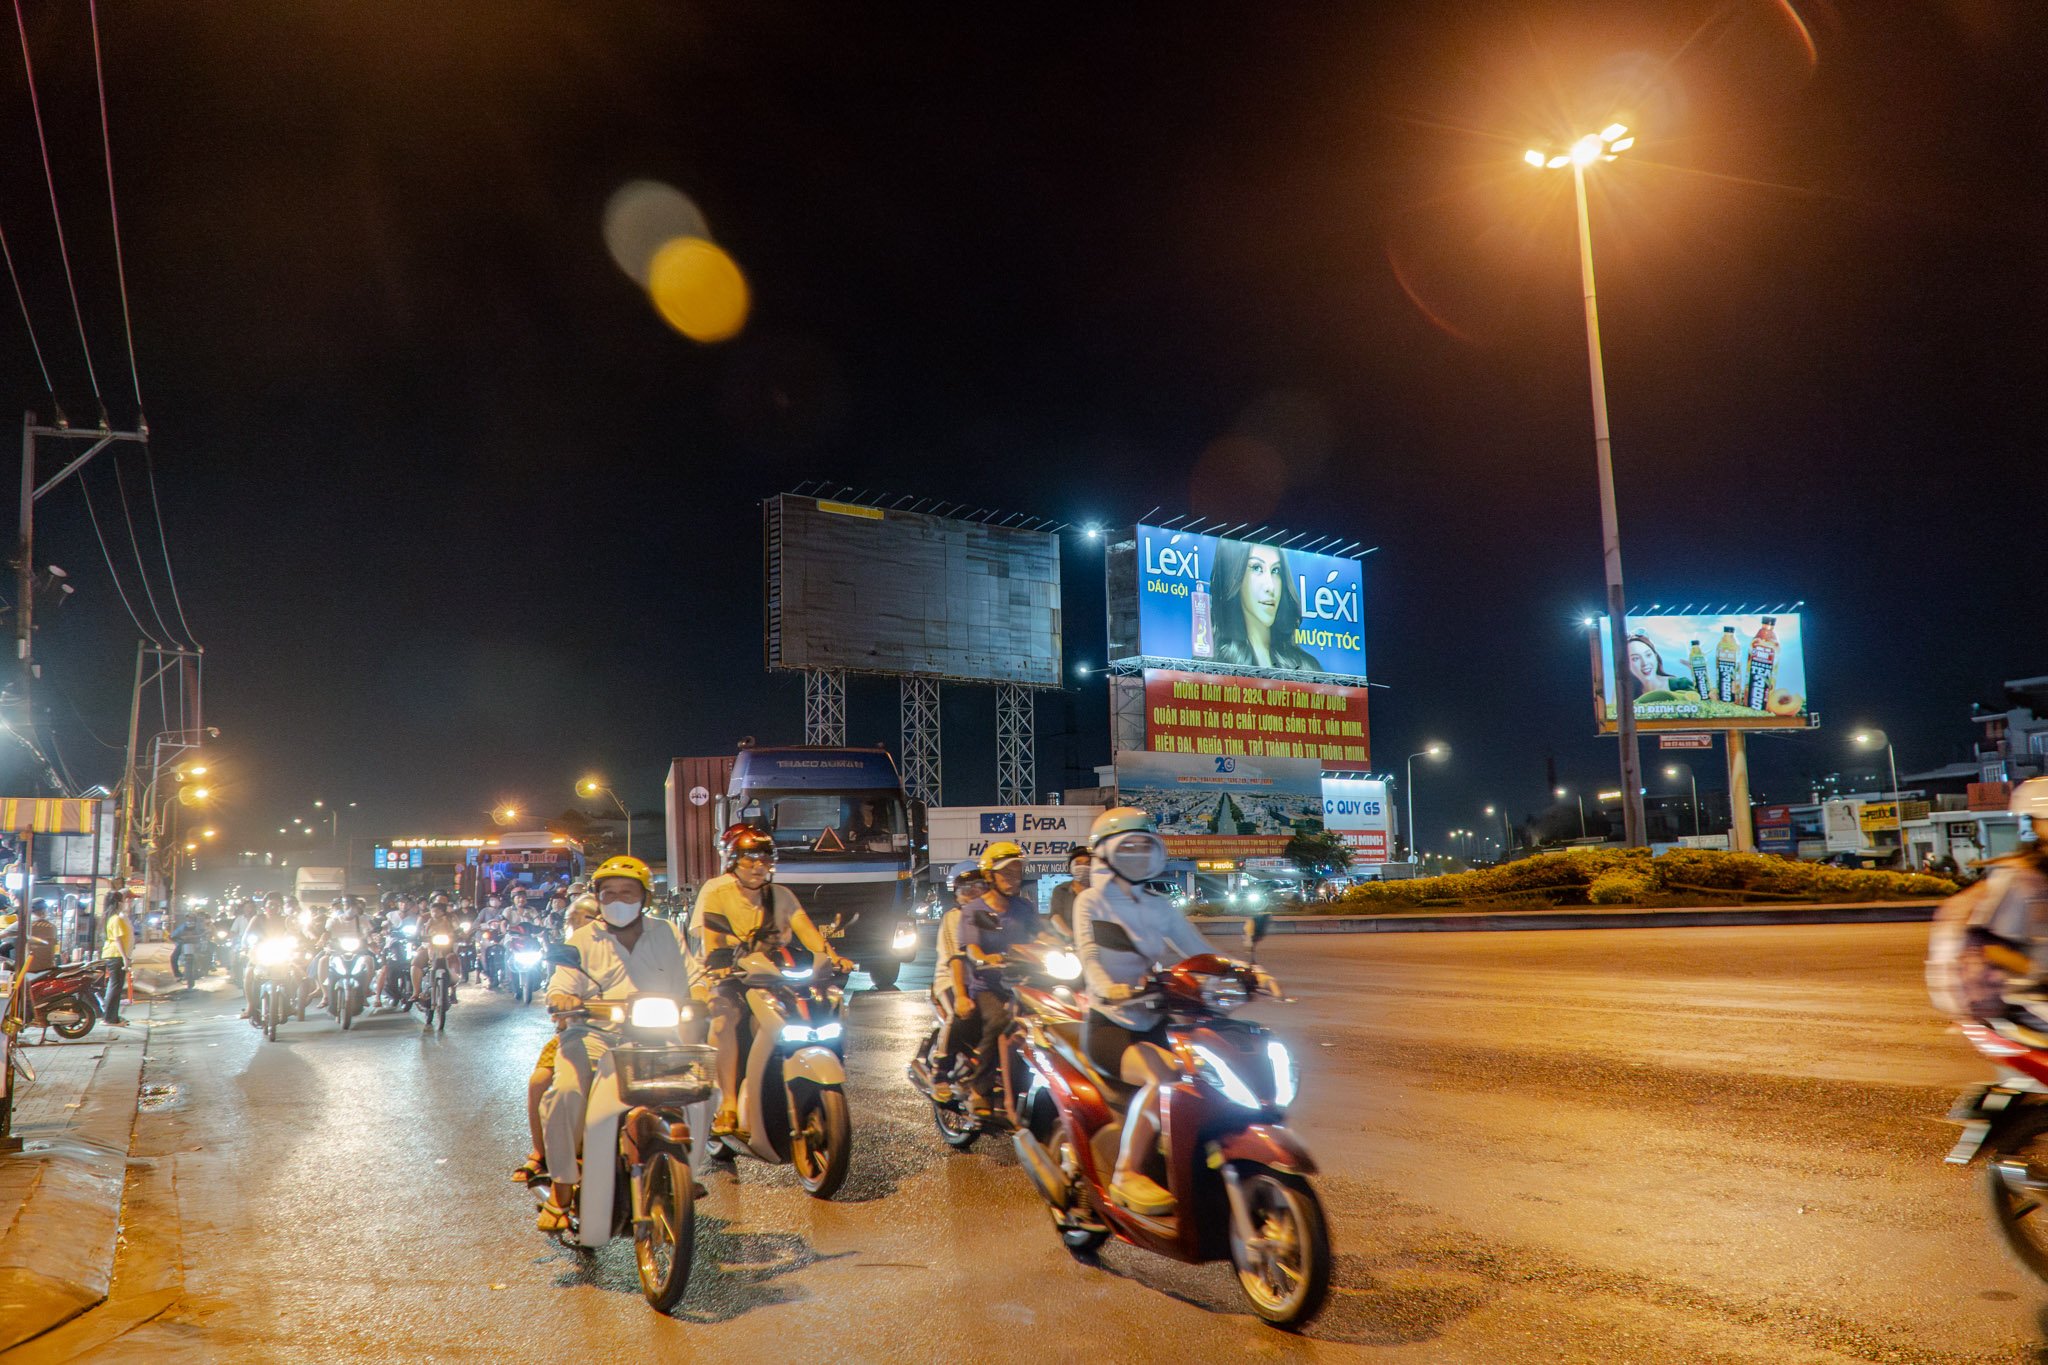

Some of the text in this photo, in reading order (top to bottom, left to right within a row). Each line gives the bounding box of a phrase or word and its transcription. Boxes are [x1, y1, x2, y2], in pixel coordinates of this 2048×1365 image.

[1145, 534, 1199, 579] Léxi
[1170, 583, 1188, 598] GỘI
[1299, 570, 1358, 622] Léxi
[1295, 629, 1360, 651] MƯỢT TÓC
[1751, 665, 1771, 679] TEA
[1174, 680, 1200, 700] MỪNG
[1202, 682, 1221, 701] NĂM
[1224, 684, 1241, 703] MỚI
[1267, 685, 1290, 707] QUYẾT
[1292, 689, 1309, 708] TÂM
[1311, 691, 1325, 710] XÂY
[1154, 705, 1177, 728] QUẬN
[1180, 706, 1200, 727] BÌNH
[1203, 708, 1219, 728] TÂN
[1222, 710, 1234, 729] CÓ
[1236, 708, 1256, 730] CHẤT
[1258, 714, 1283, 735] LƯỢNG
[1286, 711, 1306, 733] SỐNG
[1326, 717, 1340, 736] VĂN
[1197, 735, 1222, 754] NGHĨA
[1265, 738, 1290, 757] THÀNH
[1319, 742, 1343, 760] THÔNG
[1337, 800, 1361, 815] QUY
[1363, 801, 1381, 815] GS
[1033, 841, 1077, 855] EVERA
[1358, 834, 1384, 846] MINH
[1037, 863, 1050, 873] TAY
